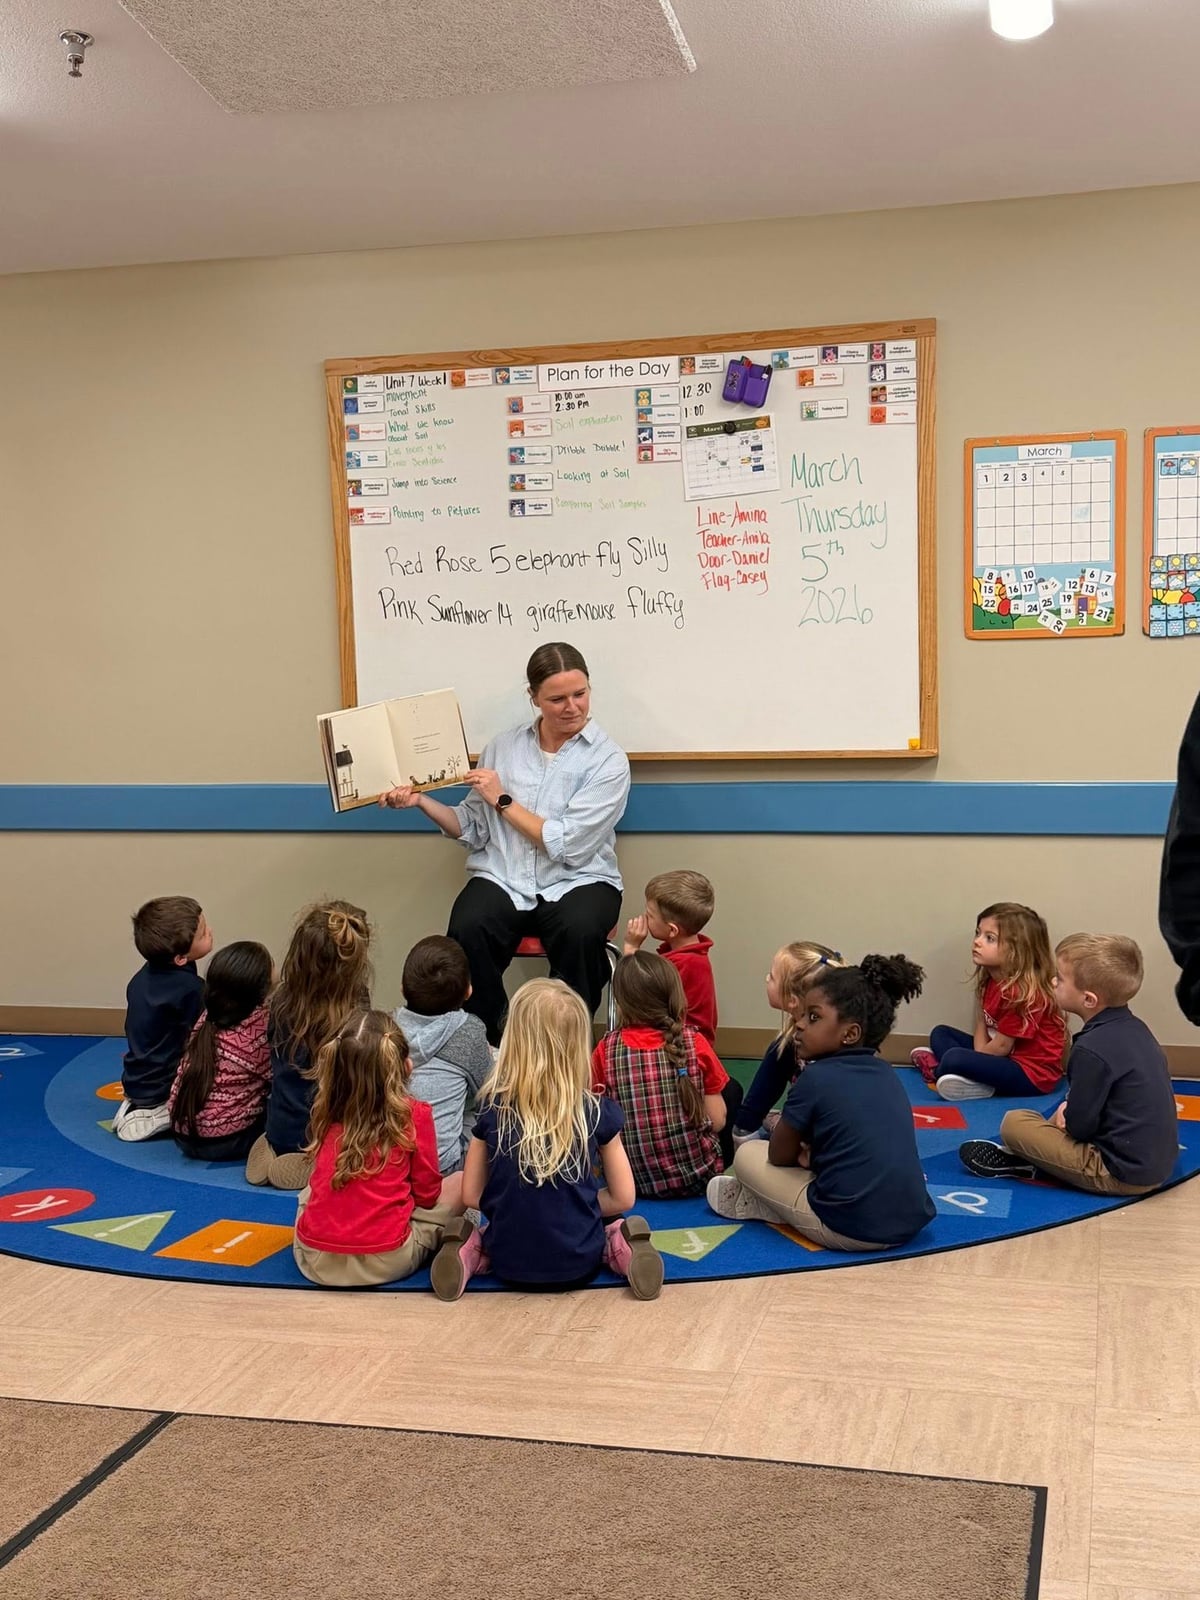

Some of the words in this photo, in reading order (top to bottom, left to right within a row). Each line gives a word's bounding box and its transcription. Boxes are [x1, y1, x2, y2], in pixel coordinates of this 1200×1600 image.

[547, 367, 580, 382] Plan
[584, 365, 604, 379] for
[609, 363, 634, 377] the
[639, 361, 671, 377] Day
[386, 376, 406, 391] Unit
[408, 375, 415, 388] 7
[418, 375, 442, 387] Week
[555, 400, 576, 412] 2:30
[1027, 446, 1063, 457] March
[791, 452, 863, 488] March
[557, 470, 592, 484] Looking
[600, 469, 609, 478] at
[614, 467, 630, 479] Soil
[984, 474, 989, 483] 1
[1003, 473, 1010, 482] 2
[1021, 473, 1028, 482] 3
[391, 477, 409, 488] Jump
[415, 478, 428, 487] into
[431, 475, 457, 486] Science
[431, 507, 441, 515] to
[780, 495, 888, 549] Thursday
[385, 546, 423, 576] Red
[436, 545, 482, 572] Rose
[489, 544, 511, 574] 5
[515, 549, 591, 575] elephant
[626, 536, 669, 572] Silly
[697, 547, 770, 568] Door-Daniel
[987, 572, 994, 581] 8
[1024, 570, 1034, 580] 10
[1089, 570, 1095, 579] 6
[1105, 574, 1112, 583] 7
[984, 585, 994, 594] 15
[1008, 585, 1019, 594] 16
[1023, 583, 1033, 593] 17
[1068, 580, 1078, 589] 12
[1085, 584, 1095, 594] 13
[984, 599, 996, 608] 22
[1041, 598, 1053, 608] 25
[1062, 594, 1072, 603] 19
[378, 586, 424, 625] Pink
[427, 594, 492, 626] Sunflower
[497, 601, 513, 626] 14
[799, 584, 874, 627] 2026
[1027, 604, 1038, 613] 24
[1096, 609, 1108, 619] 21
[1053, 620, 1064, 632] 29
